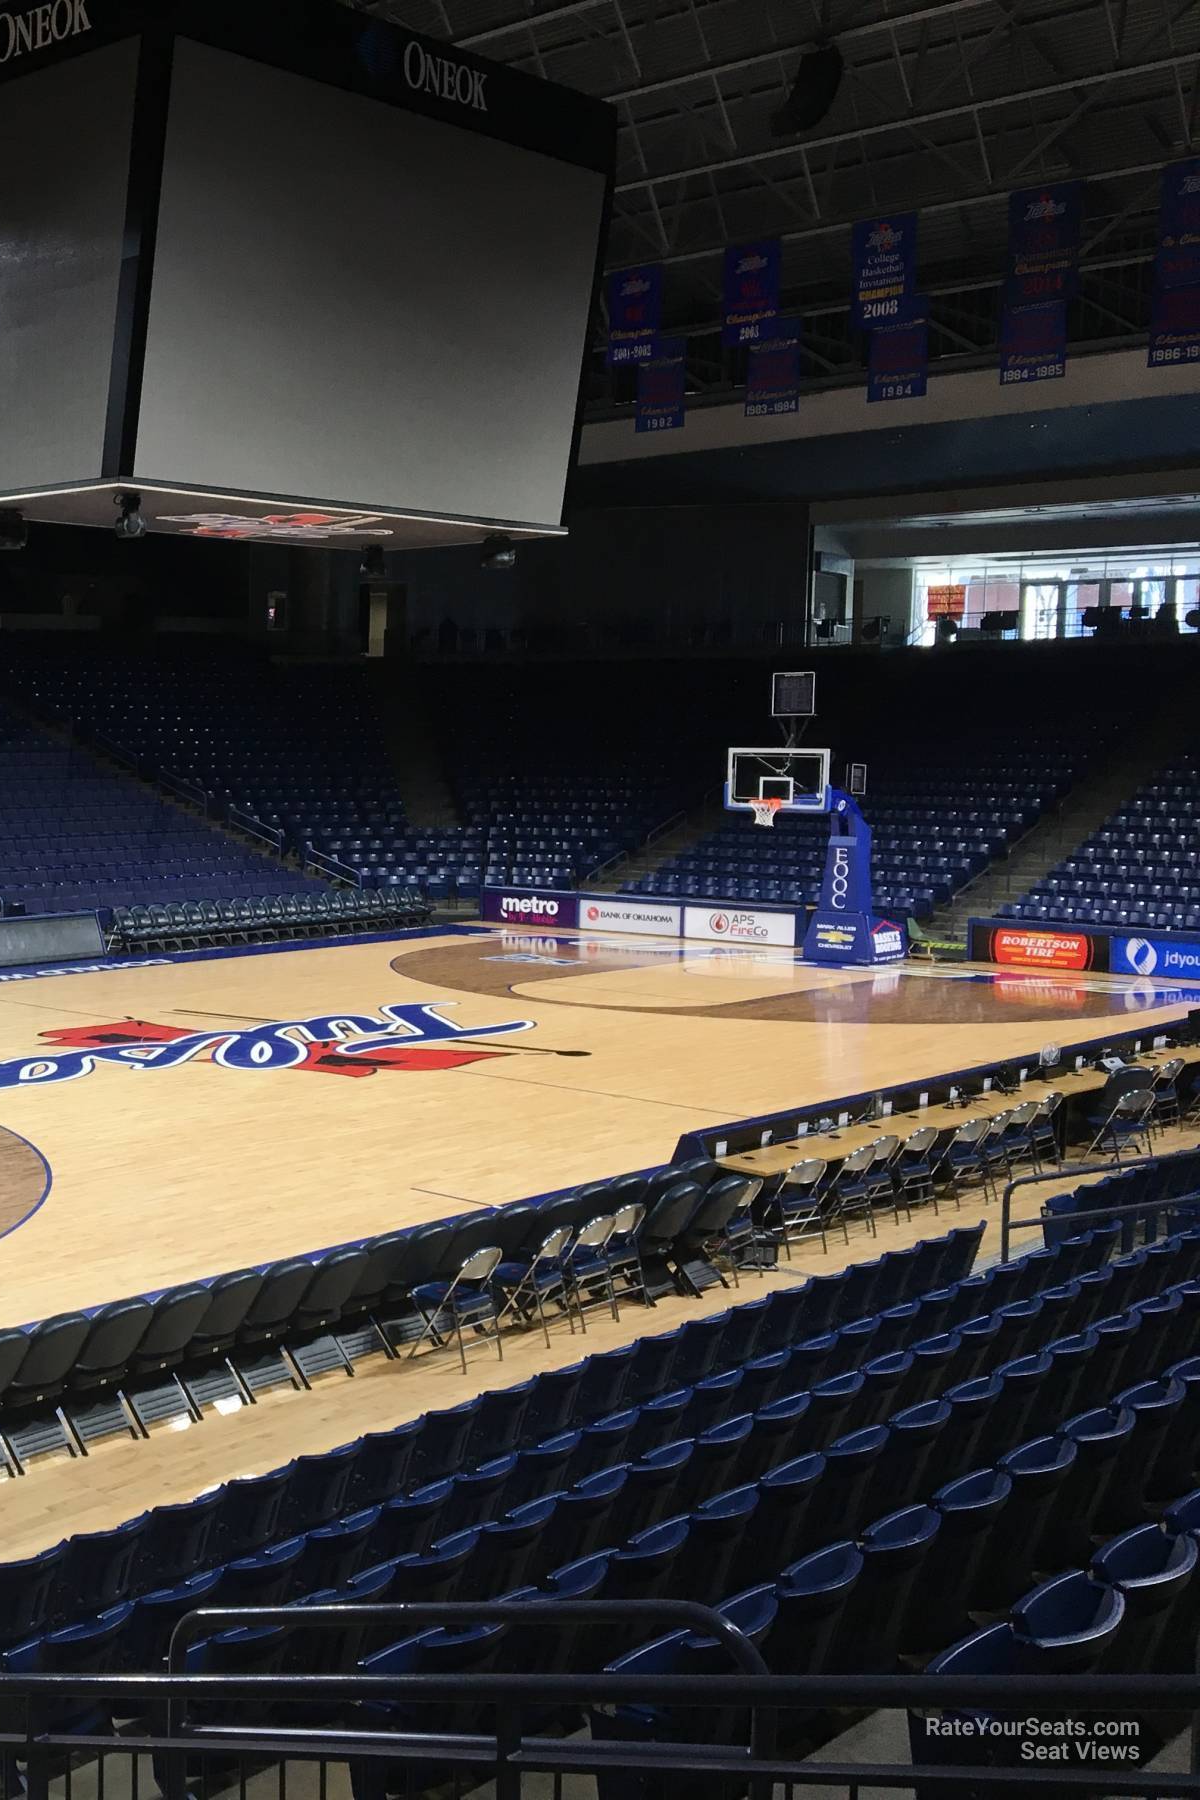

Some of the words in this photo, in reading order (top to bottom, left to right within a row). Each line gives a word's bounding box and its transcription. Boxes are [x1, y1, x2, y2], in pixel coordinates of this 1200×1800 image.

[403, 40, 489, 112] ONEOK
[867, 253, 900, 267] College
[861, 263, 905, 279] Basketball
[858, 274, 905, 290] Invitational
[863, 299, 899, 319] 2008
[726, 309, 777, 326] Champions
[1151, 345, 1200, 362] 1986-19
[1003, 362, 1064, 383] 1984-1985
[881, 384, 913, 399] 1984
[746, 400, 797, 417] 1983-1984
[647, 416, 673, 430] 1982
[502, 896, 559, 916] metro
[600, 911, 621, 920] BANK
[622, 912, 632, 920] OF
[731, 914, 755, 925] APS
[817, 942, 853, 951] CHEVROLET
[1001, 936, 1080, 950] ROBERTSON
[1025, 946, 1056, 958] TIRE
